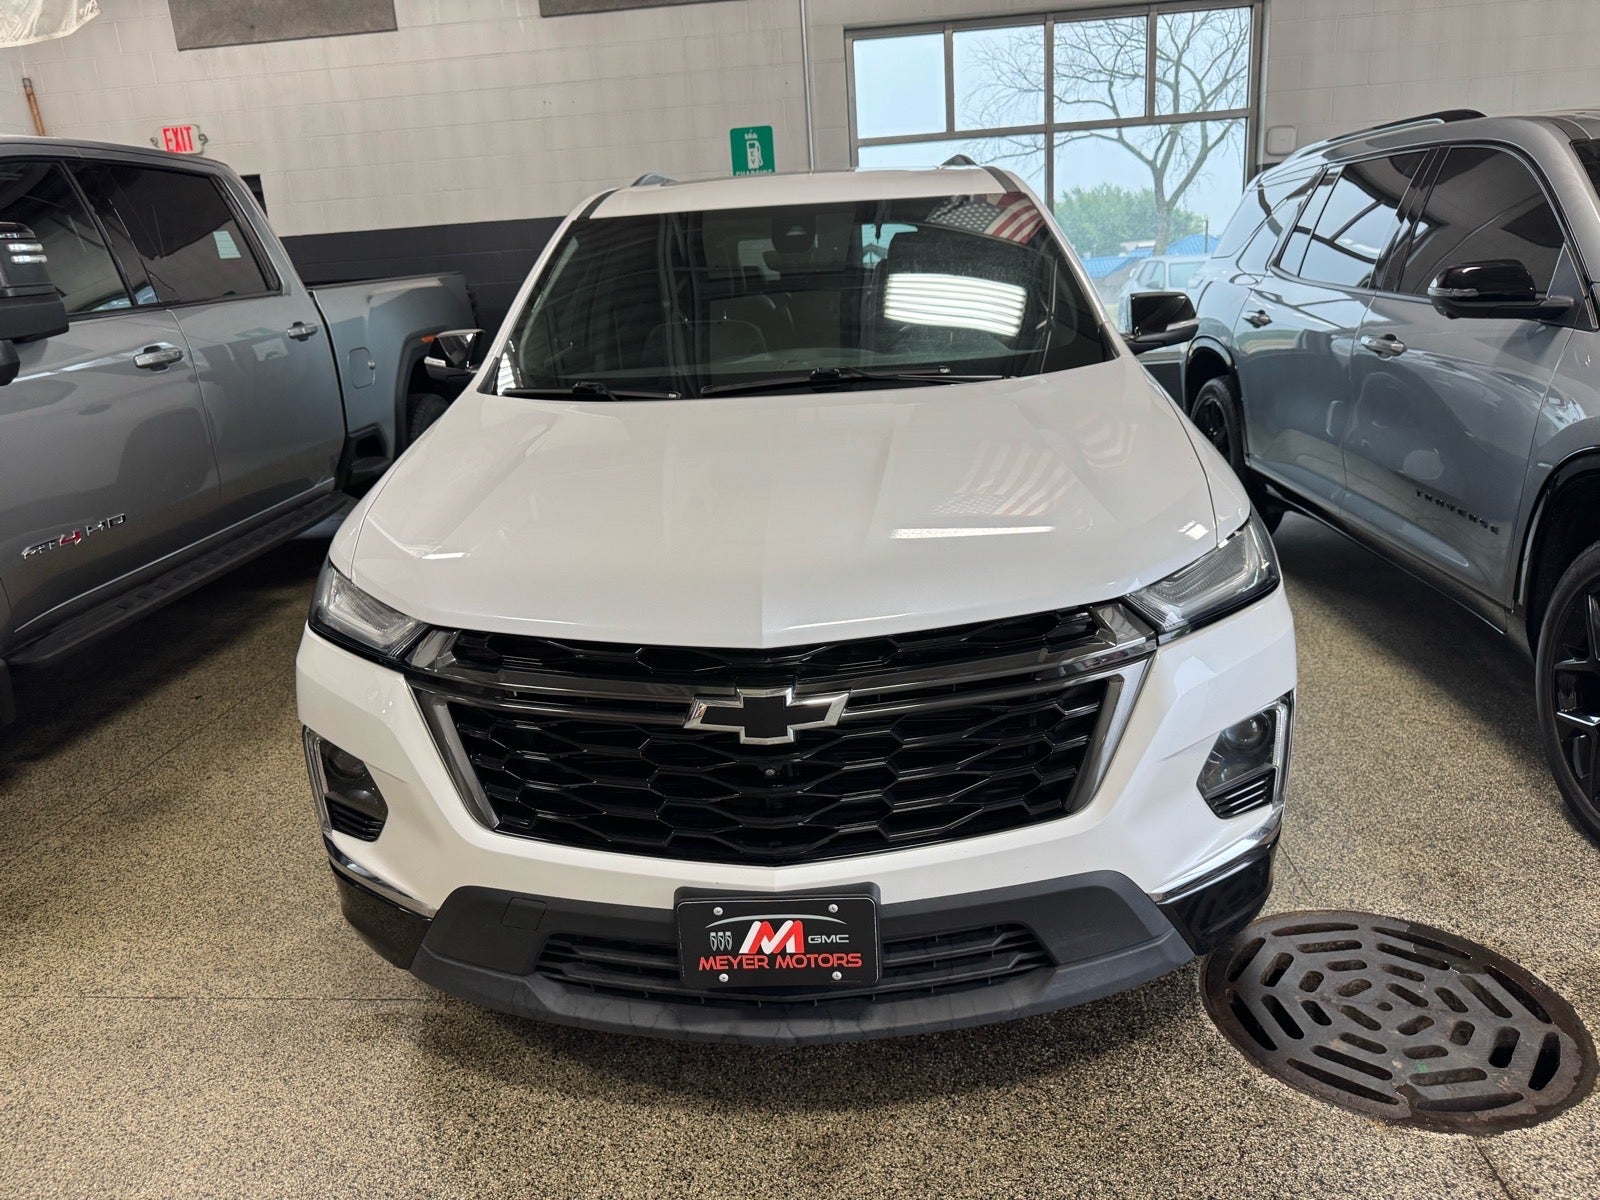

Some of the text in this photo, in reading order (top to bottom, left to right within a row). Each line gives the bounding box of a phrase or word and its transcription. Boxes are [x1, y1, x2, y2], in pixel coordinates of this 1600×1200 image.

[162, 126, 193, 153] EXIT
[808, 934, 850, 944] GMC
[699, 953, 862, 971] MEYER MOTORS
